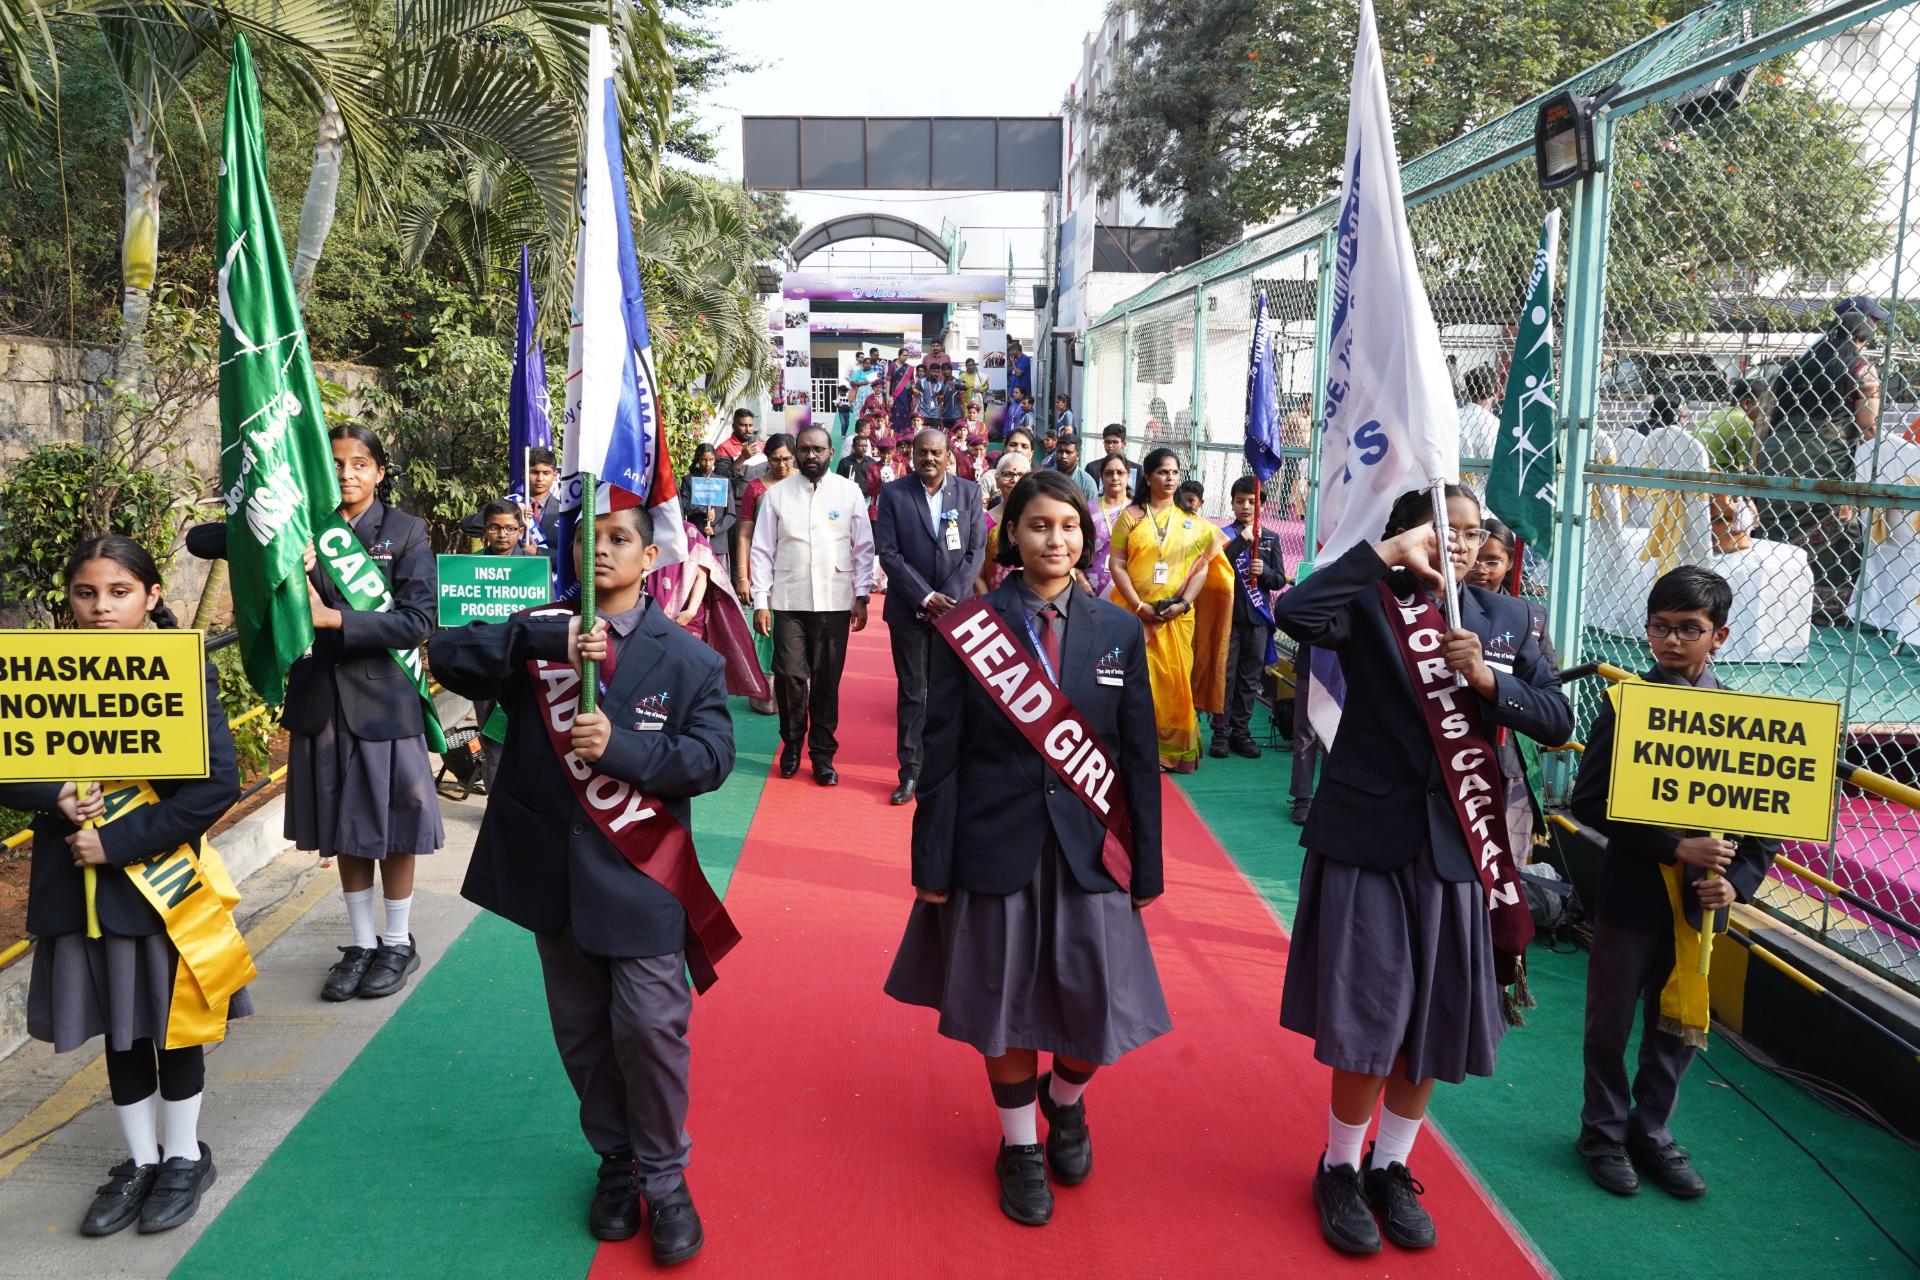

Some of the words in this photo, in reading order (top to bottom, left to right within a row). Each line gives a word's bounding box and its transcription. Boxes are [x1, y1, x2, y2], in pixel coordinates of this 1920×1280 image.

[246, 461, 304, 547] INSAT
[441, 584, 481, 598] PEACE
[484, 585, 545, 600] THROUGH
[475, 567, 511, 581] INSAT
[1235, 551, 1265, 608] APTAIN
[0, 693, 184, 719] NOWLEDGE
[951, 609, 1053, 724] HEAD
[1044, 719, 1116, 816] GIRL
[1648, 706, 1807, 747] BHASKARA
[4, 731, 35, 757] IS
[46, 729, 163, 756] POWER
[1633, 740, 1816, 782] KNOWLEDGE
[564, 750, 656, 833] BOY
[1651, 777, 1679, 803] IS
[1688, 780, 1790, 815] POWER
[1450, 748, 1520, 911] CAPTAIN
